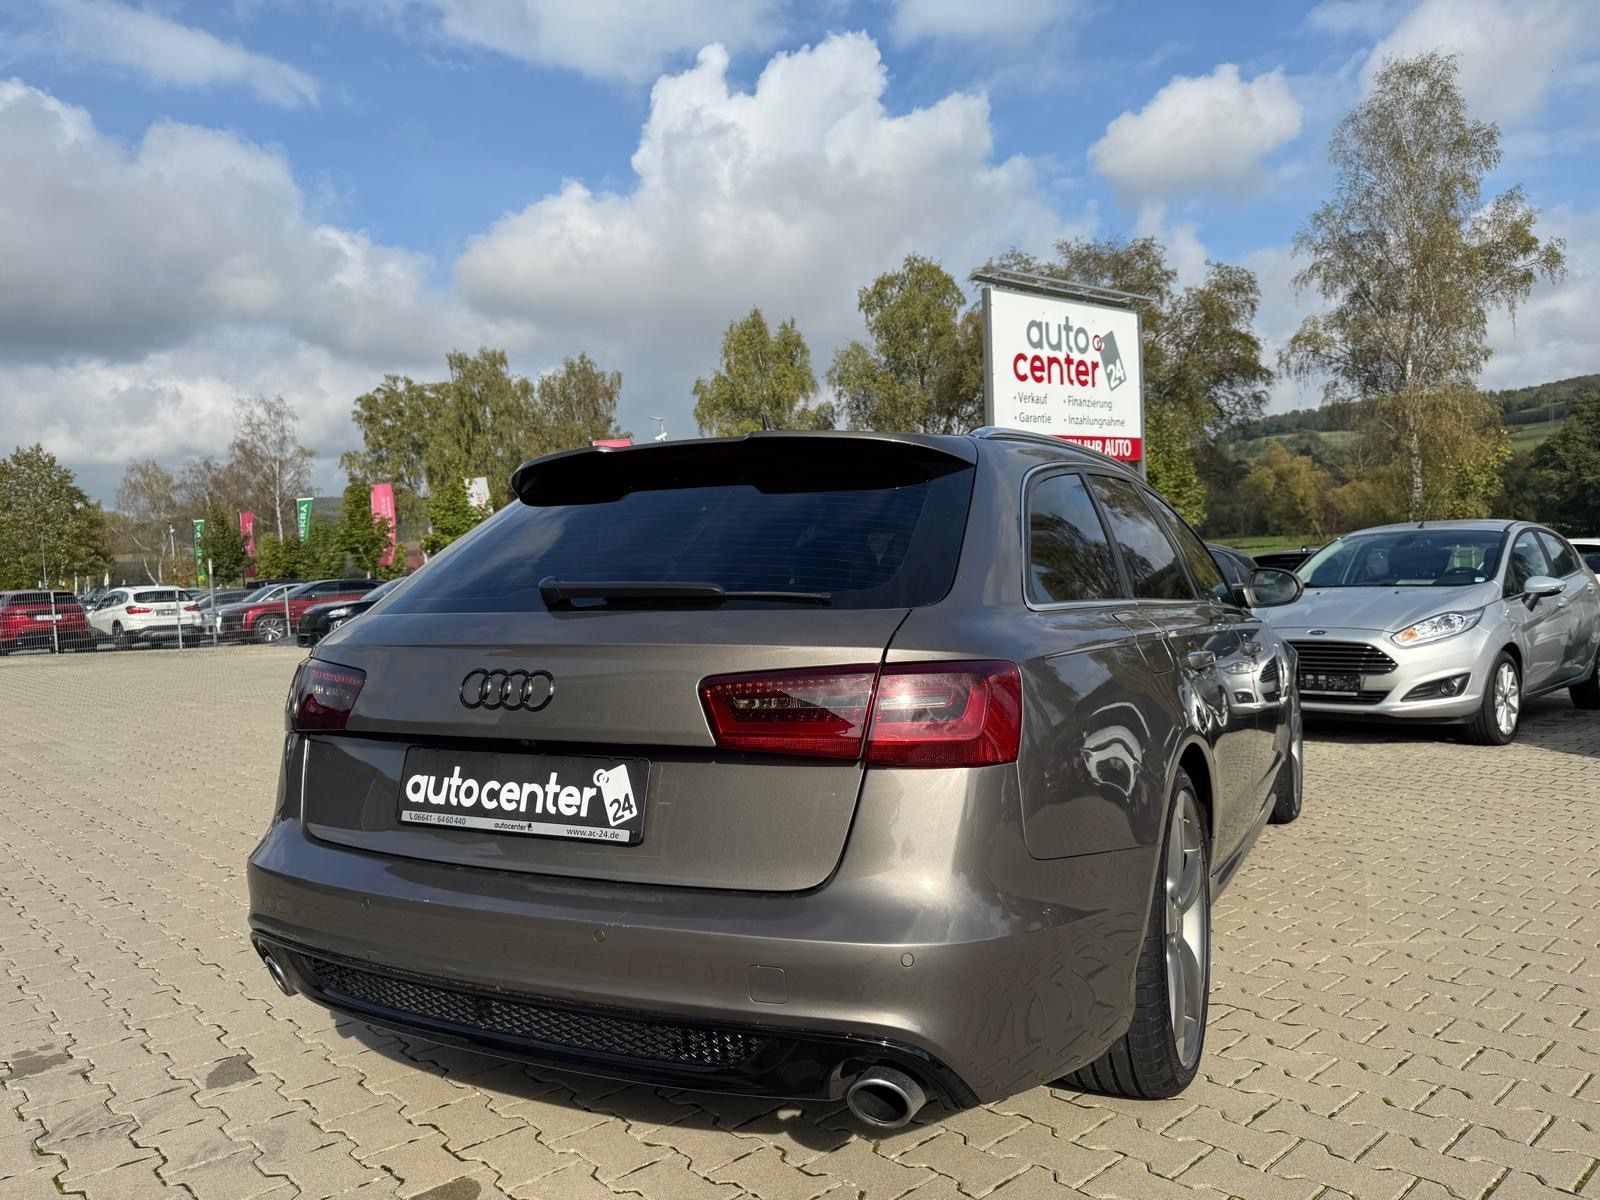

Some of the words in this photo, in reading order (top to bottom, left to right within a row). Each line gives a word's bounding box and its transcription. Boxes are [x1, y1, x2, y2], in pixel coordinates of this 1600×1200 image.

[1026, 316, 1090, 354] auto
[1013, 351, 1099, 387] center
[1106, 358, 1124, 385] 24
[1018, 392, 1048, 405] Verkauf
[1068, 395, 1113, 411] Finanzierung
[1019, 412, 1052, 424] Garantie
[1068, 415, 1125, 429] Inzahlungnahme
[1104, 438, 1132, 457] AUTO
[405, 765, 597, 818] autocenter
[609, 792, 634, 823] 24
[494, 822, 527, 831] autocenter
[566, 828, 620, 840] www.ac-24.de
